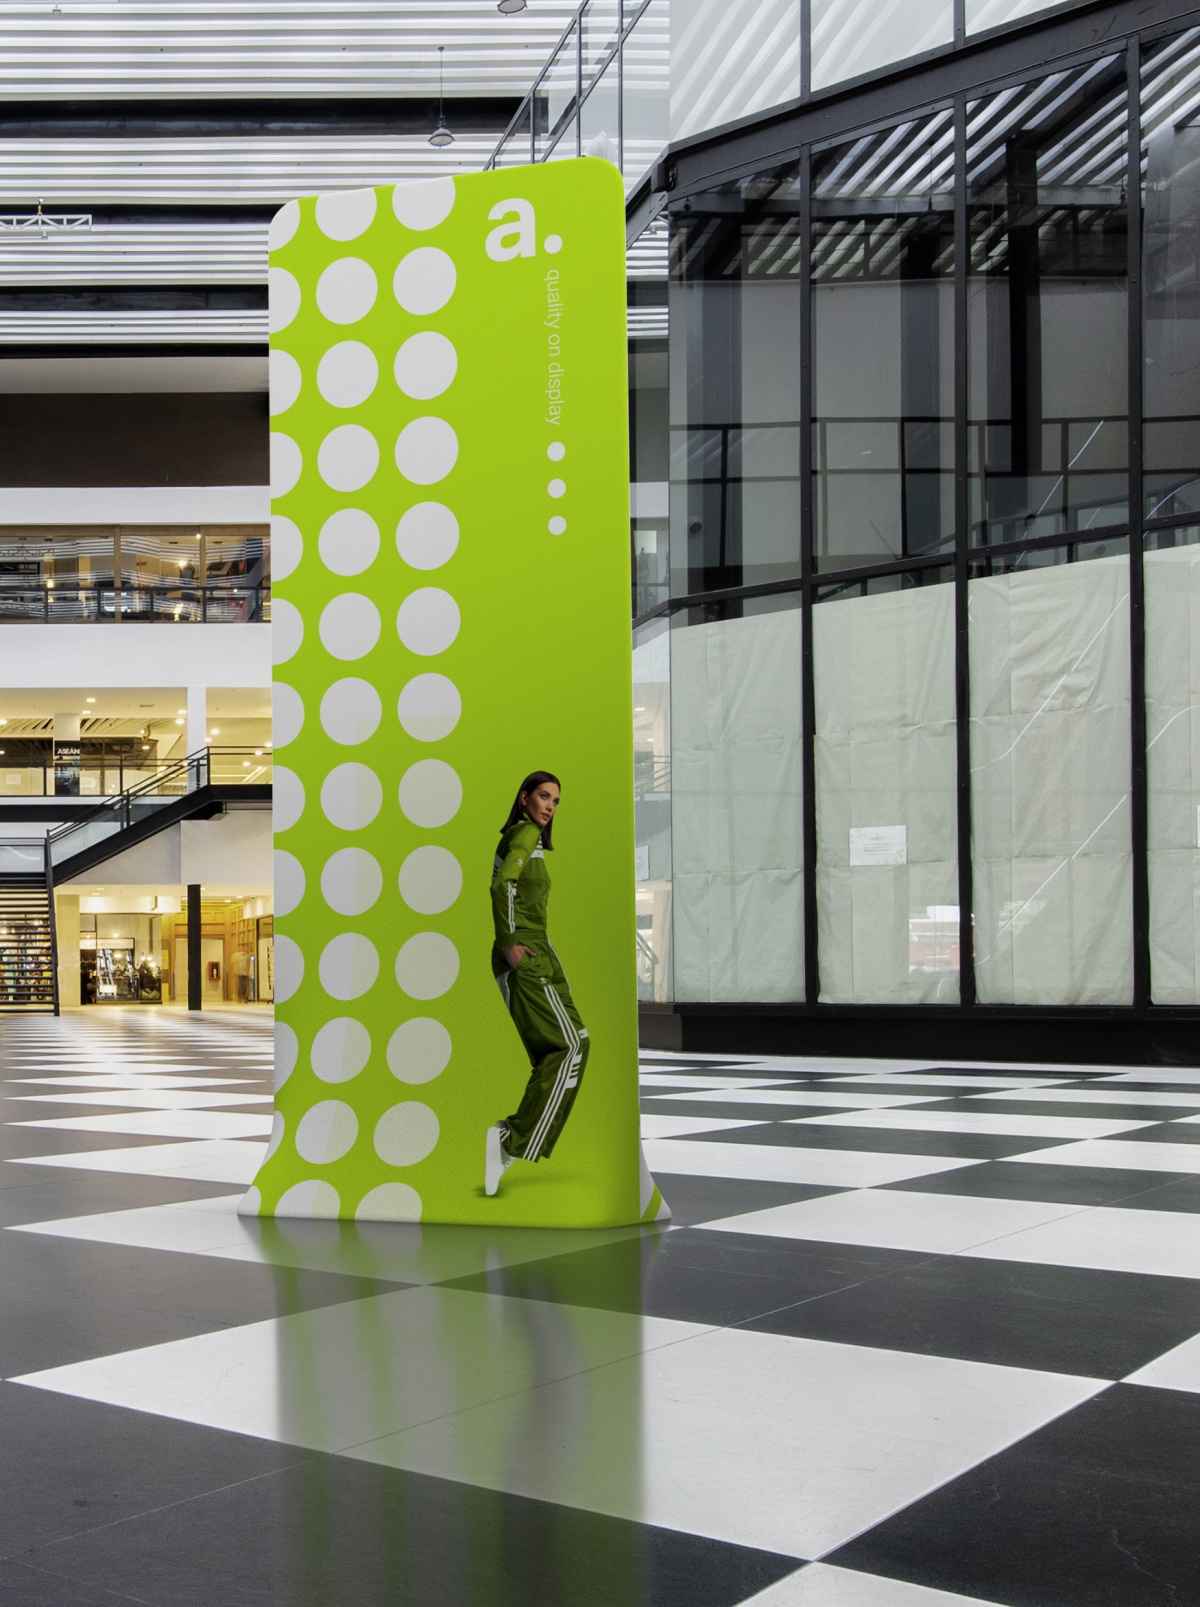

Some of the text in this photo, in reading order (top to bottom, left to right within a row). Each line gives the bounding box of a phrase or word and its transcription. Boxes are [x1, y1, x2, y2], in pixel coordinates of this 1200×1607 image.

[484, 197, 563, 263] a.
[543, 269, 565, 426] quality on display
